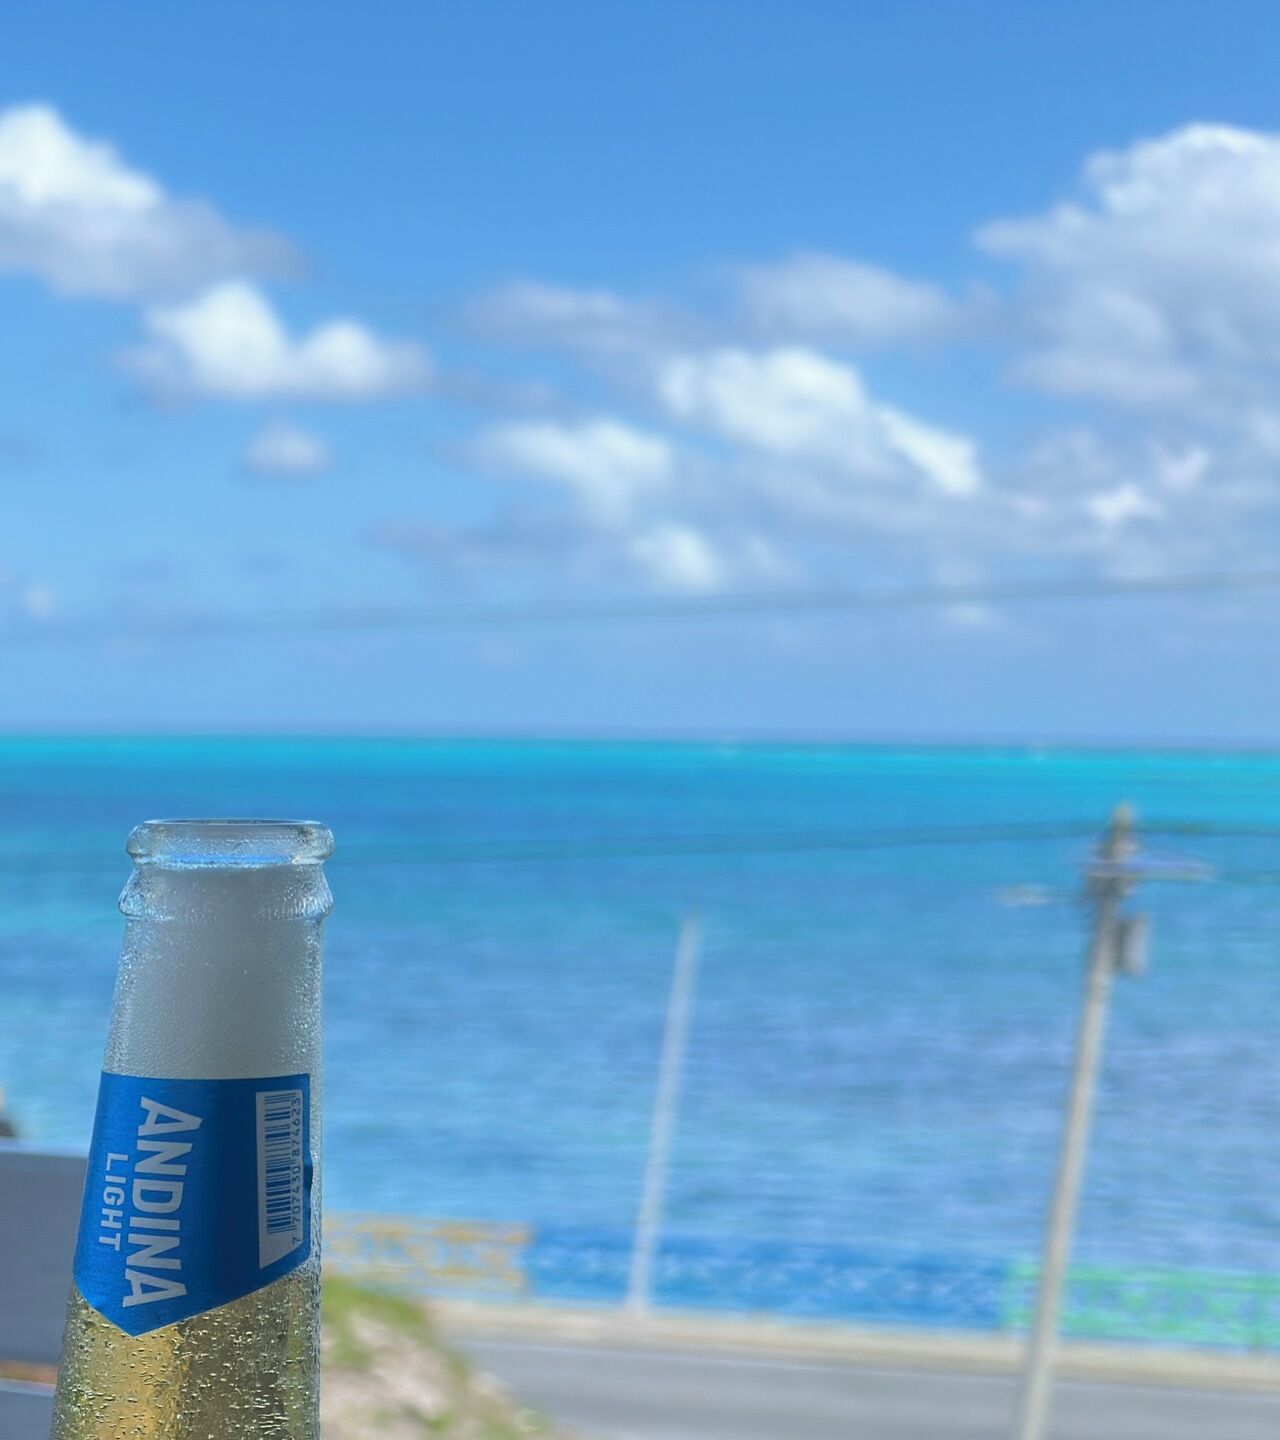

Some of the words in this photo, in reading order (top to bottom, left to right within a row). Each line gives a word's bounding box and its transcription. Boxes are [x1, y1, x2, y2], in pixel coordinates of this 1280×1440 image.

[291, 1097, 301, 1157] 874623
[99, 1152, 129, 1251] LIGHT
[122, 1096, 203, 1308] ANDINA
[291, 1165, 301, 1225] 707430
